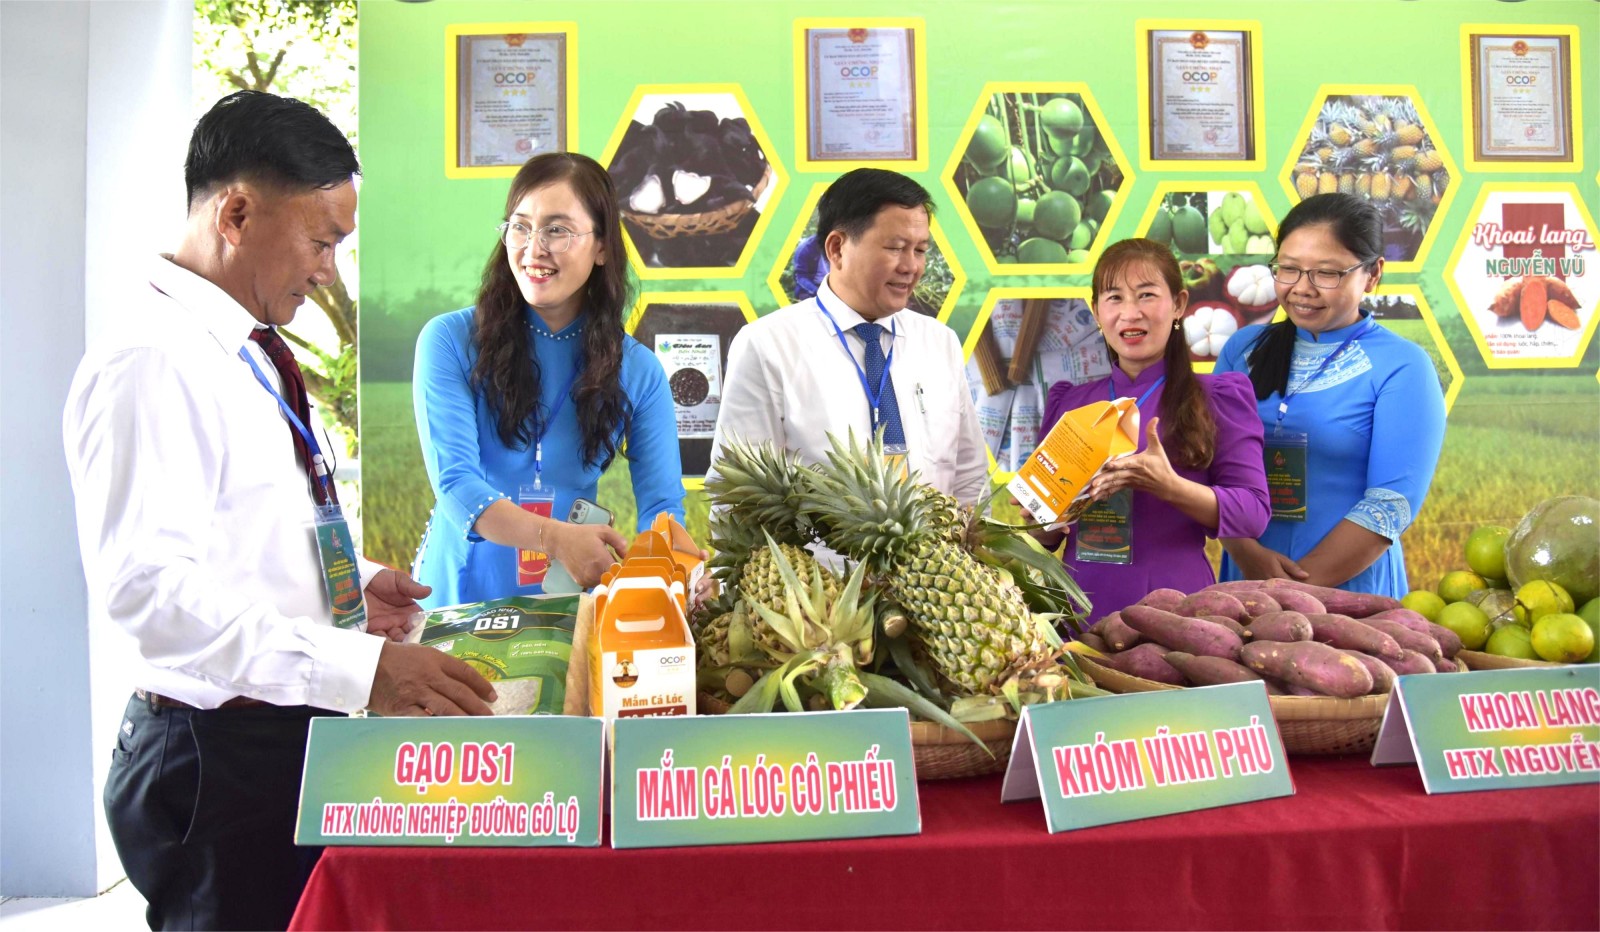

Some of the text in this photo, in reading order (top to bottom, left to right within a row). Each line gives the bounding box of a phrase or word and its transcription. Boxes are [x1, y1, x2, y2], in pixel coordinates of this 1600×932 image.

[494, 72, 535, 84] OCOP
[840, 66, 878, 77] OCOP
[1182, 72, 1217, 81] OCOP
[1506, 76, 1536, 84] OCOP
[1472, 223, 1596, 252] Khoai lang
[1486, 249, 1584, 276] NGUYỄN VŨ
[474, 615, 520, 631] DS1
[660, 656, 686, 664] OCOP
[622, 693, 683, 707] Mắm Cá Lóc
[1458, 687, 1600, 732] KHOAI LANG
[394, 742, 514, 794] GẠO DS1
[1052, 715, 1275, 798] KHÓM VĨNH PHÚ
[1444, 748, 1502, 780] HTX
[637, 744, 896, 820] MẮM CÁ LÓC CÔ PHIẾU
[322, 792, 580, 842] HTX NÔNG NGHIỆP ĐƯỜNG GỖ LỘ
